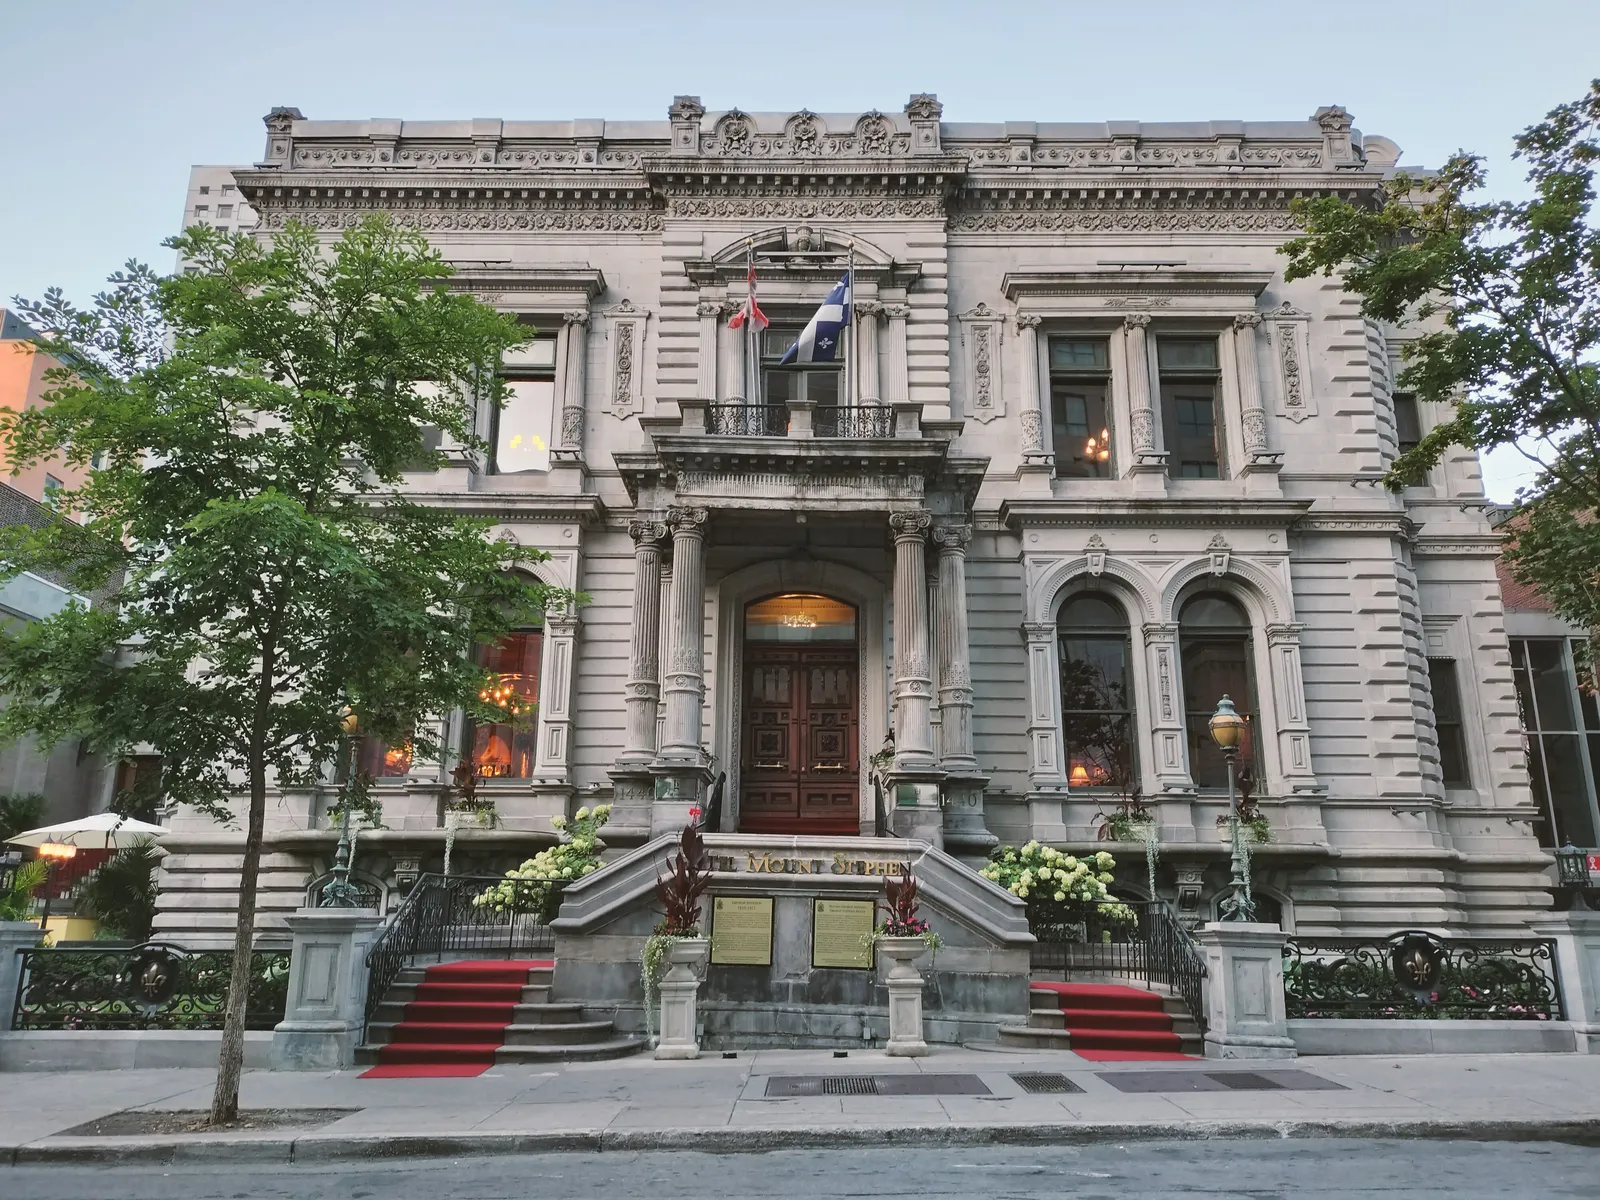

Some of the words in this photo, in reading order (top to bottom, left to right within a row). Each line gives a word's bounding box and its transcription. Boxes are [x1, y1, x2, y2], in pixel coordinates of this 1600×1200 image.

[941, 792, 977, 807] 1440
[745, 851, 825, 874] MOUNT
[830, 852, 911, 876] STEPHEN
